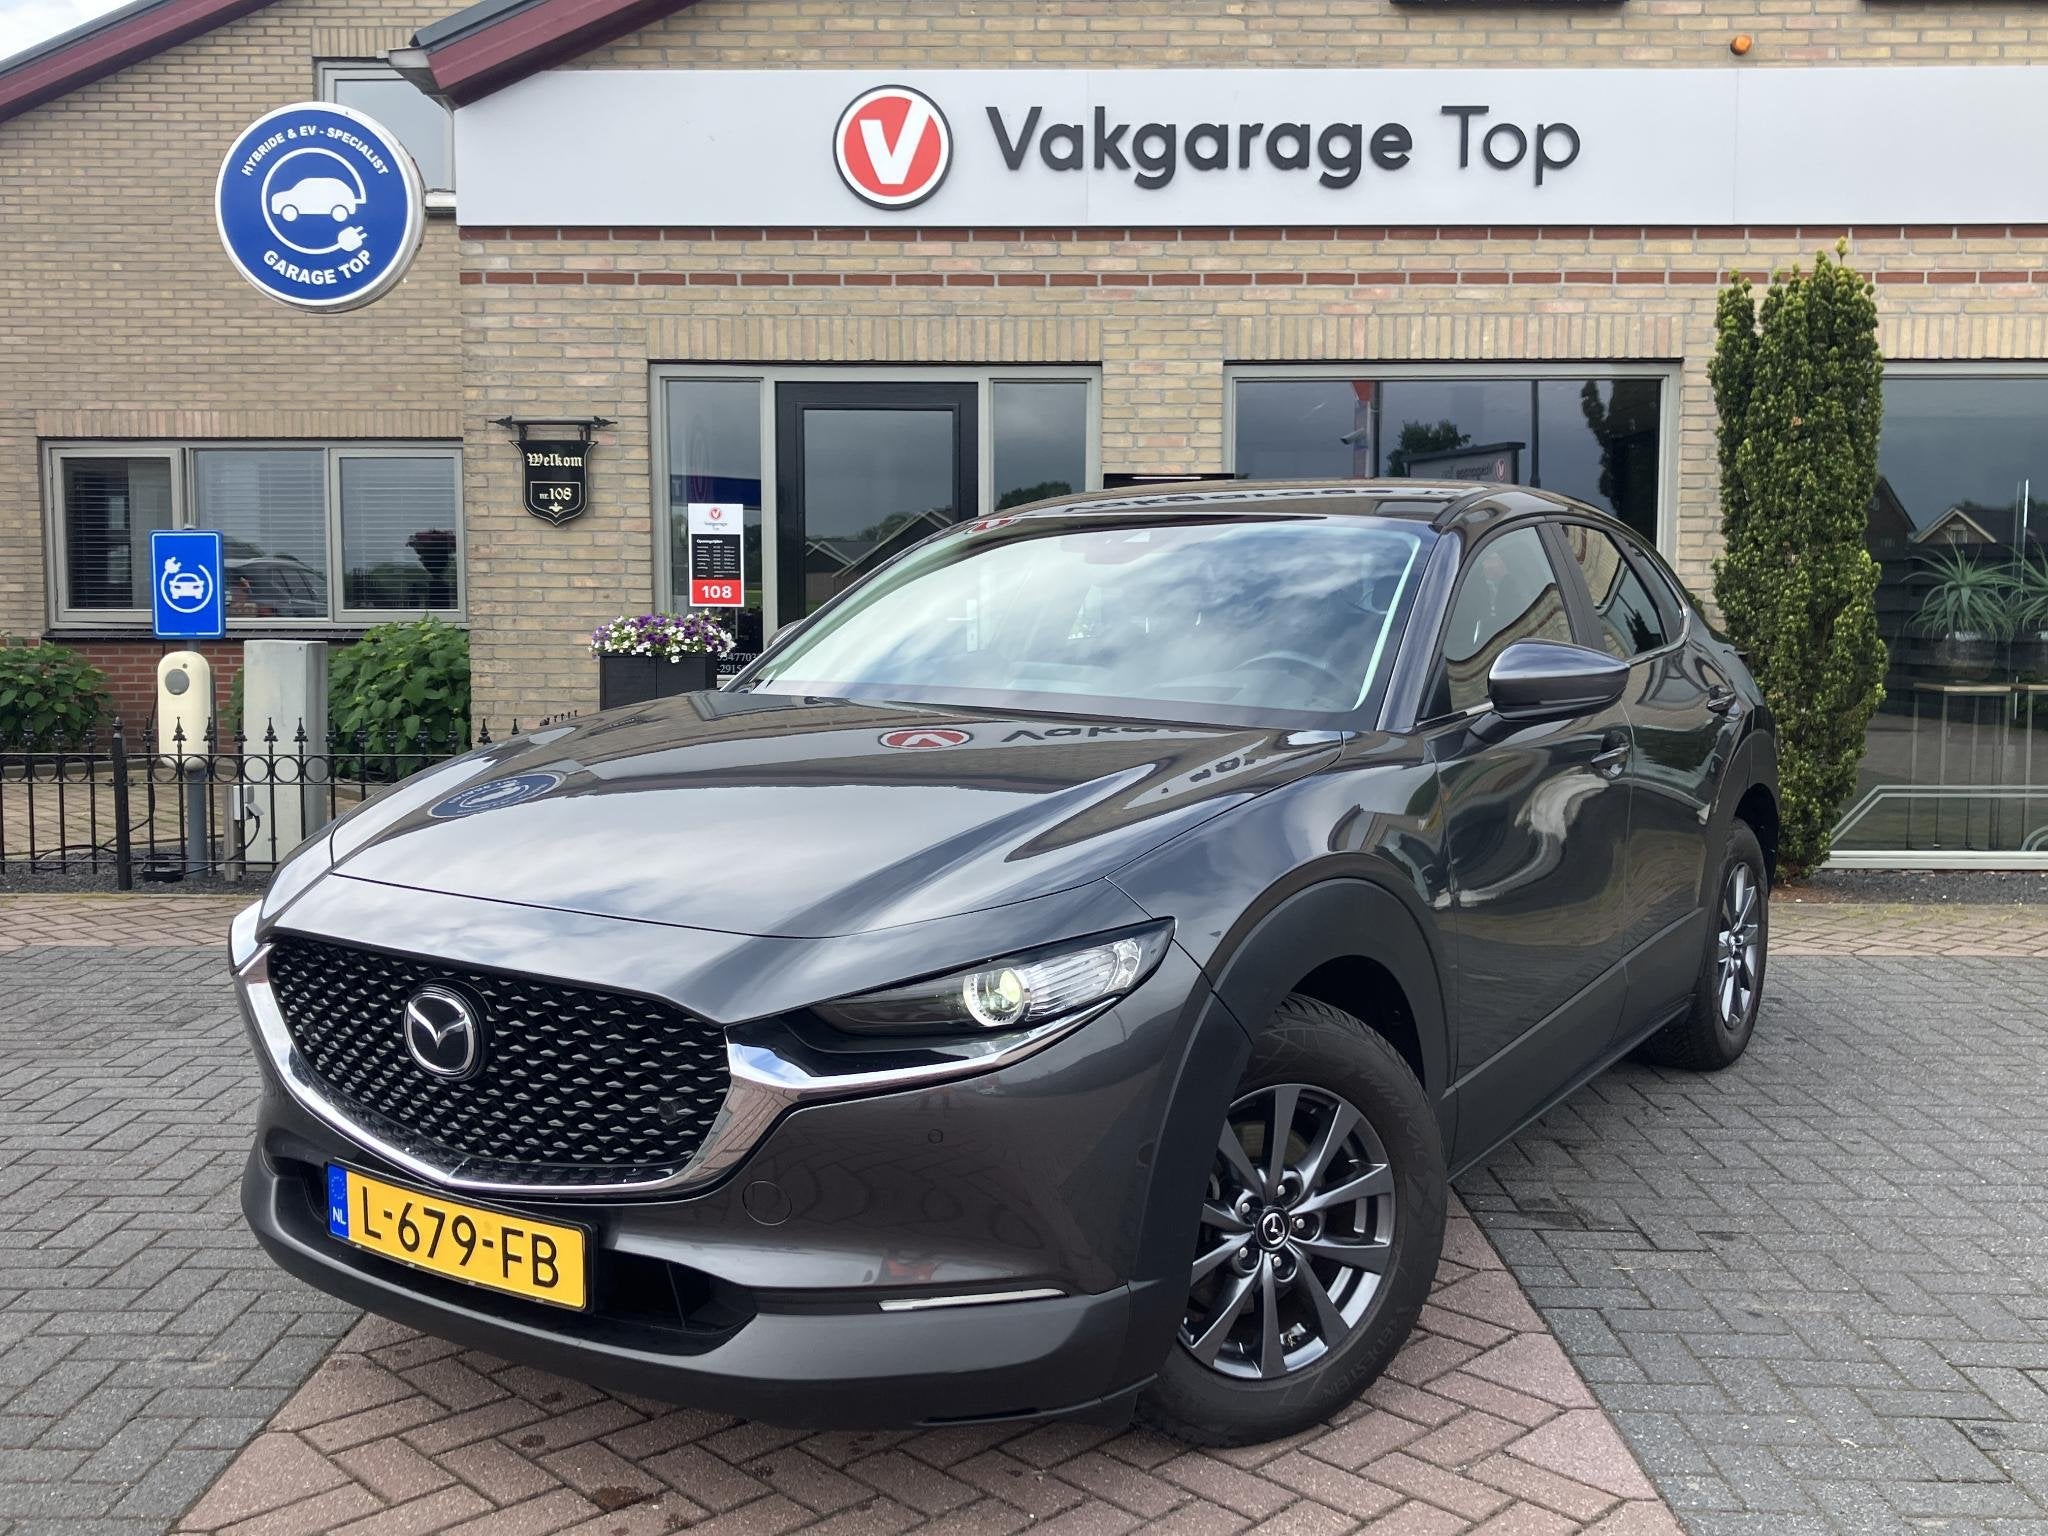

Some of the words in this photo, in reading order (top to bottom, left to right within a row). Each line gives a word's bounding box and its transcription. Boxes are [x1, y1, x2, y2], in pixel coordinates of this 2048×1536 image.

[241, 132, 285, 177] HYBRIDE
[287, 128, 298, 140] &
[299, 125, 317, 137] EV
[326, 127, 390, 176] SPECIALIST
[985, 105, 1413, 190] Vakgarage
[1440, 105, 1581, 187] Top
[263, 250, 338, 286] GARAGE
[338, 249, 372, 279] TOP
[526, 452, 583, 467] Welkom
[701, 585, 732, 599] 108
[332, 1206, 347, 1225] NL
[362, 1186, 559, 1289] L-679-FB
